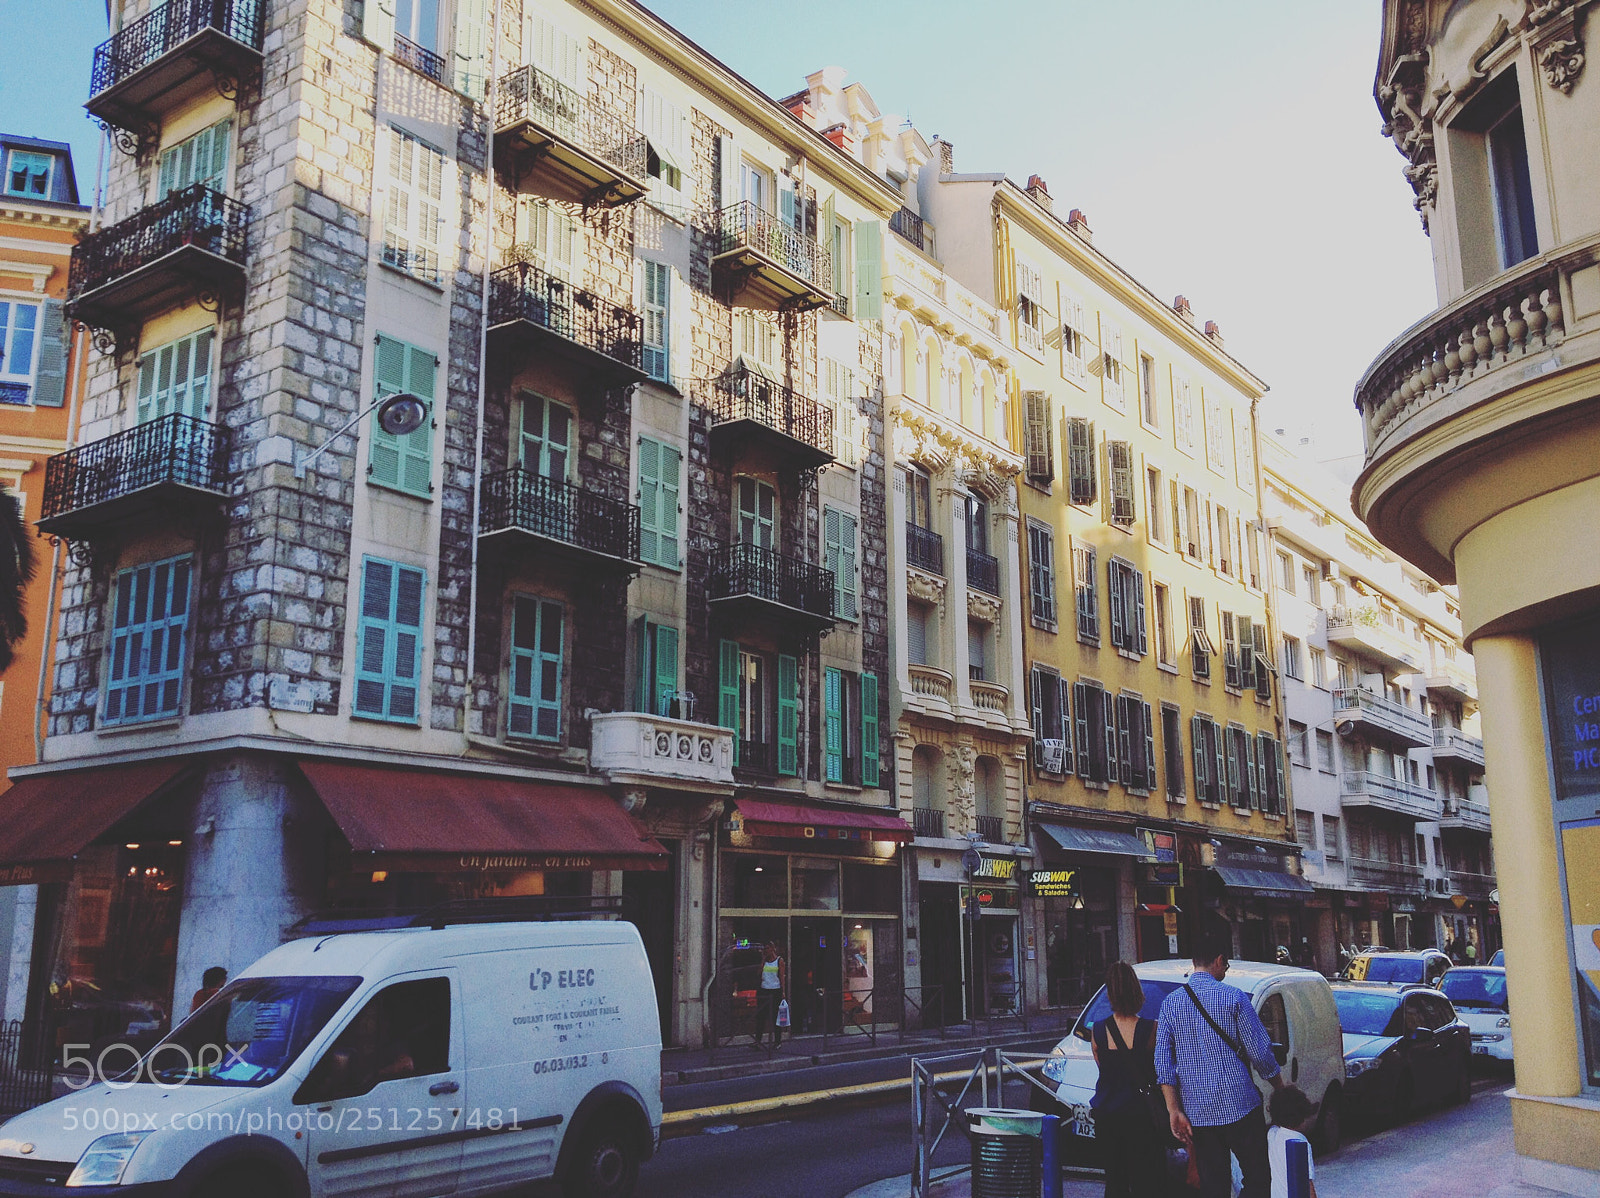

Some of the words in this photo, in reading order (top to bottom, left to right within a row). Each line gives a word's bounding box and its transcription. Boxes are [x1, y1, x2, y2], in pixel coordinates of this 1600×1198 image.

[1030, 871, 1075, 883] SUBWAY
[558, 968, 595, 989] ELEC
[512, 1014, 544, 1026] COURANT
